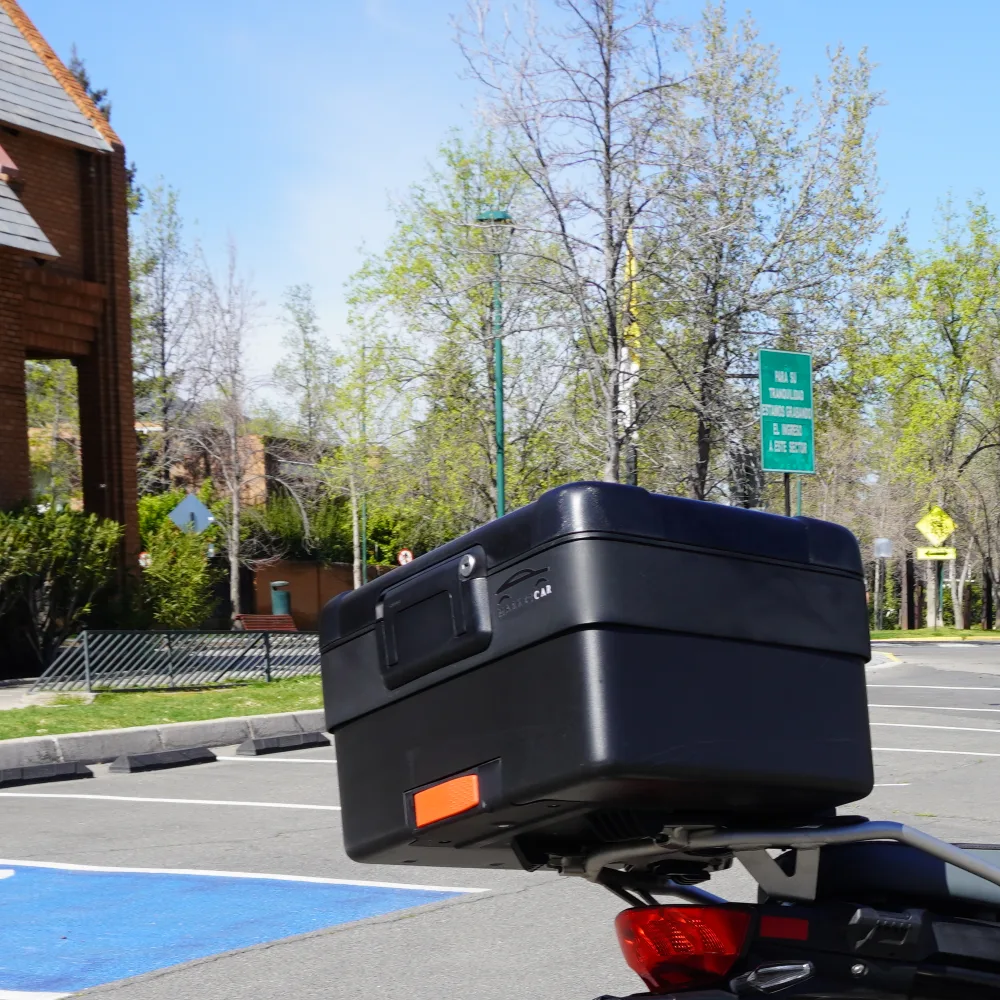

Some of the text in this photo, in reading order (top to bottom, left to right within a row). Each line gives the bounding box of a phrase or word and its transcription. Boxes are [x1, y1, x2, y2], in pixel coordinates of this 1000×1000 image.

[774, 370, 797, 384] PARA SU
[773, 423, 780, 435] EL
